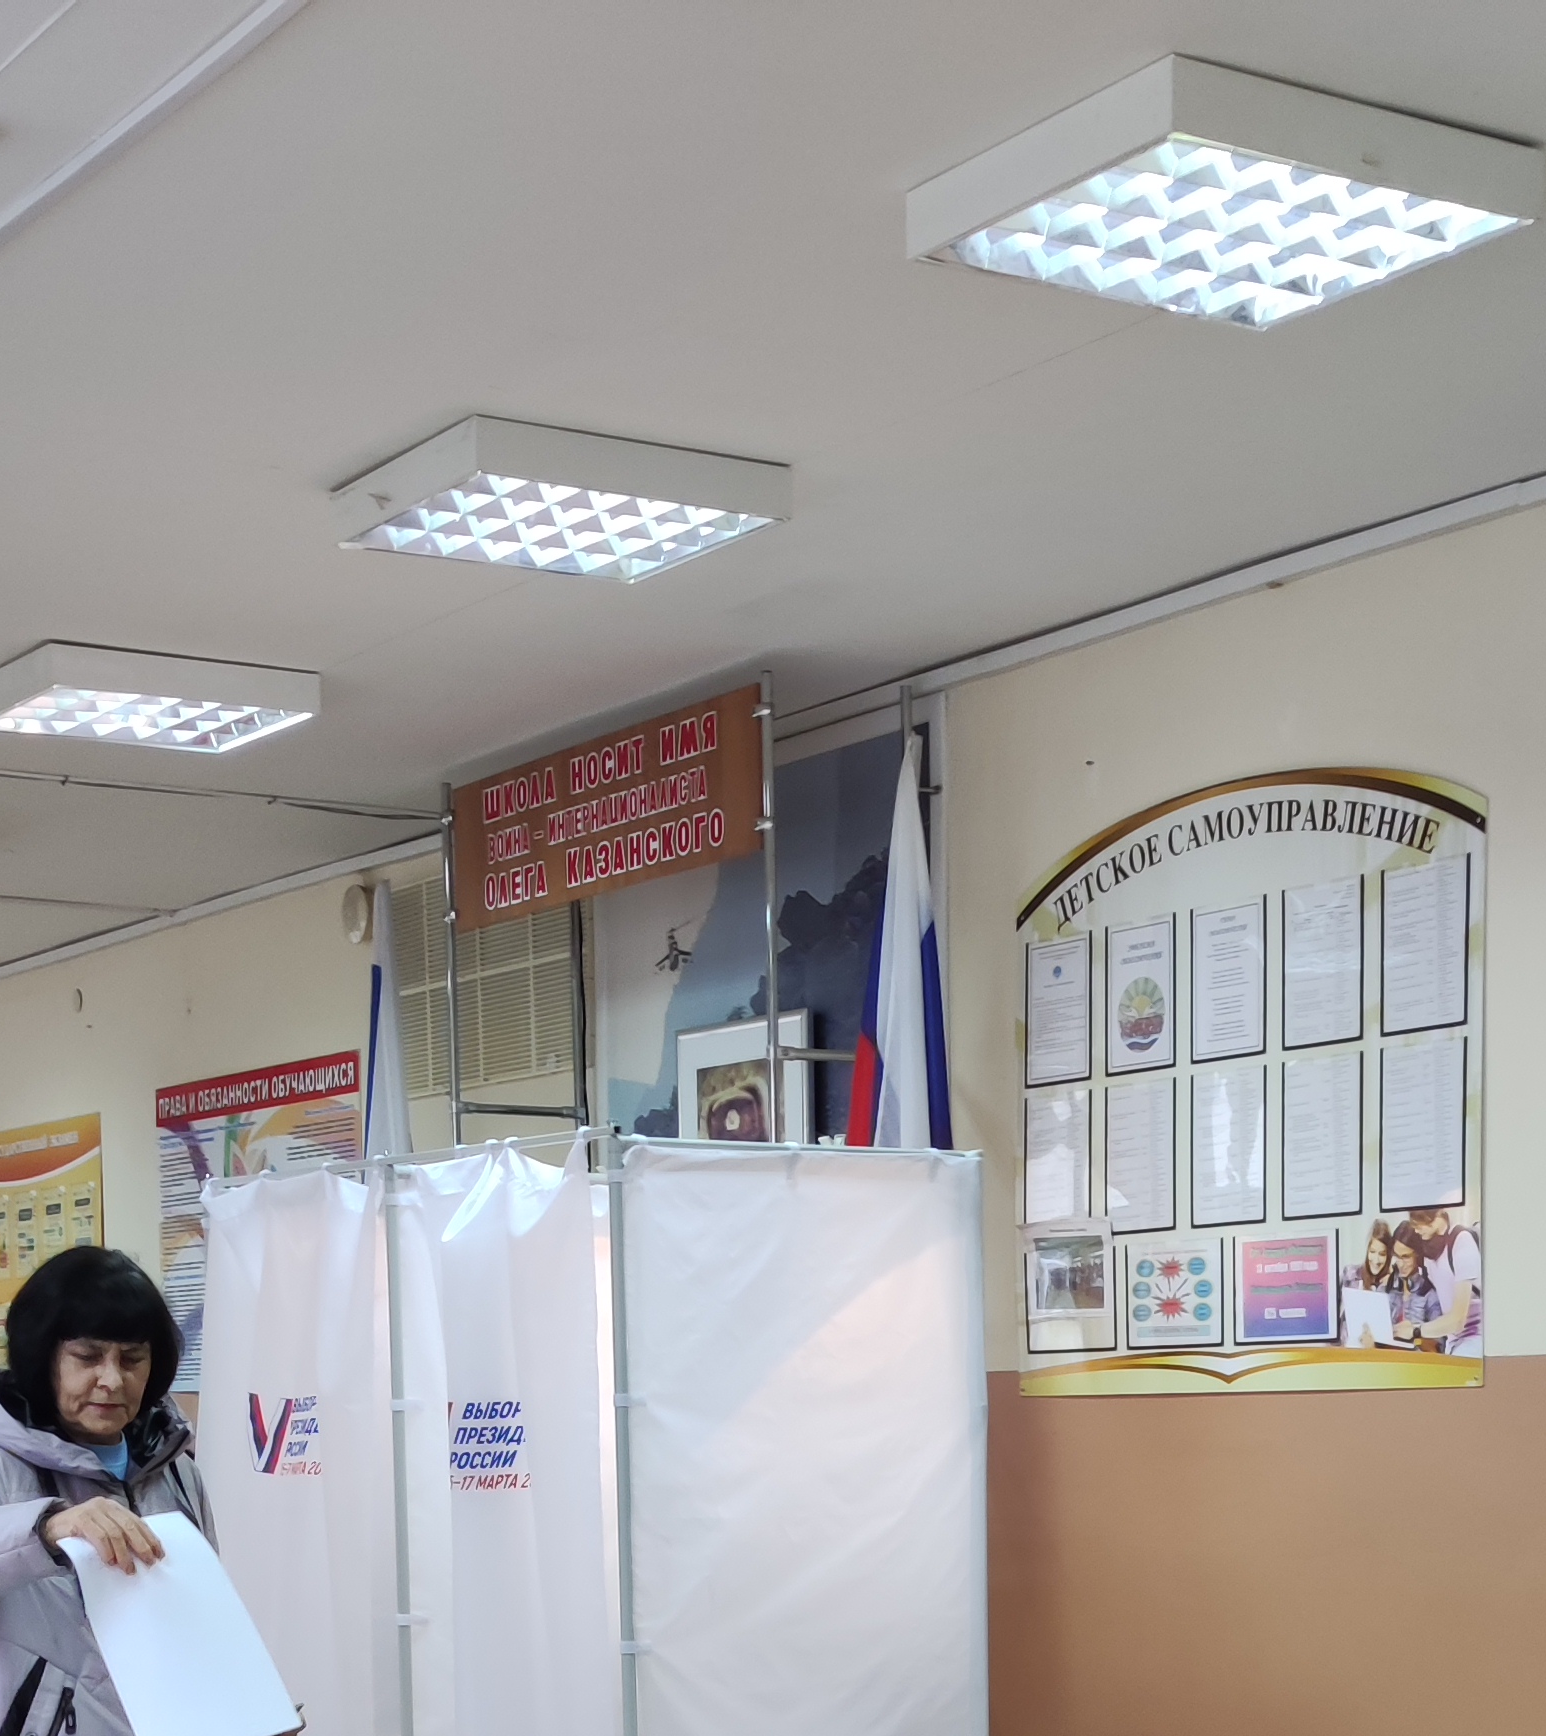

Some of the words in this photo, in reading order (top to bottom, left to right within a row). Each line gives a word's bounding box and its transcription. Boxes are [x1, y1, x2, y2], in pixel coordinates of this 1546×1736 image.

[482, 766, 557, 824] ШКОЛА
[570, 734, 644, 795] НОСИТ
[659, 710, 718, 766] ИМЯ
[487, 822, 531, 865] ВОИНА
[547, 765, 708, 846] ИНТЕРНАЦИОНАЛИСТА
[484, 860, 549, 911] ОЛЕГА
[565, 808, 725, 889] КАЗАНСКОГО
[1051, 833, 1163, 932] ДЕТСКОЕ
[1167, 797, 1441, 858] САМОУПРАВЛЕНИЕ
[158, 1096, 188, 1120] ПРАВА
[189, 1094, 196, 1114] И
[197, 1077, 269, 1113] ОБЯЗАННОСТИ
[271, 1061, 354, 1099] ОБУЧАЮЩИХСЯ
[450, 1450, 518, 1470] РОССИИ
[453, 1425, 526, 1447] ПРЕЗИД
[475, 1473, 518, 1490] МАРТА
[520, 1472, 532, 1489] 2
